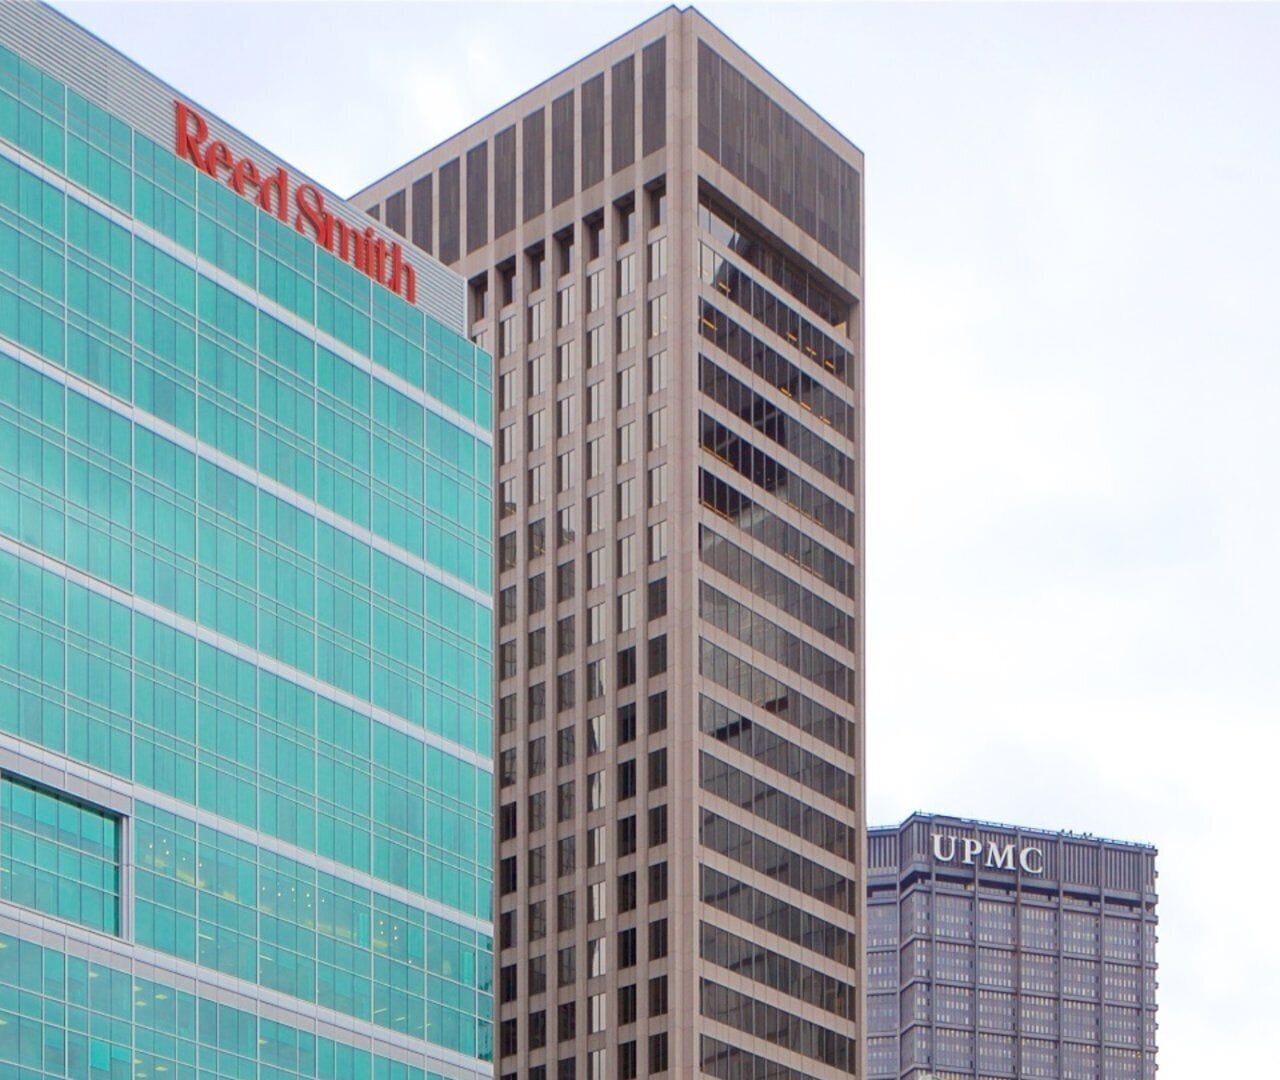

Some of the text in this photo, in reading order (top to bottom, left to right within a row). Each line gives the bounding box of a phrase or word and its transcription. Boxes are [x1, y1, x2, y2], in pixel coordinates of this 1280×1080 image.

[174, 101, 416, 305] Reed Smith
[930, 834, 1043, 874] UPMC
